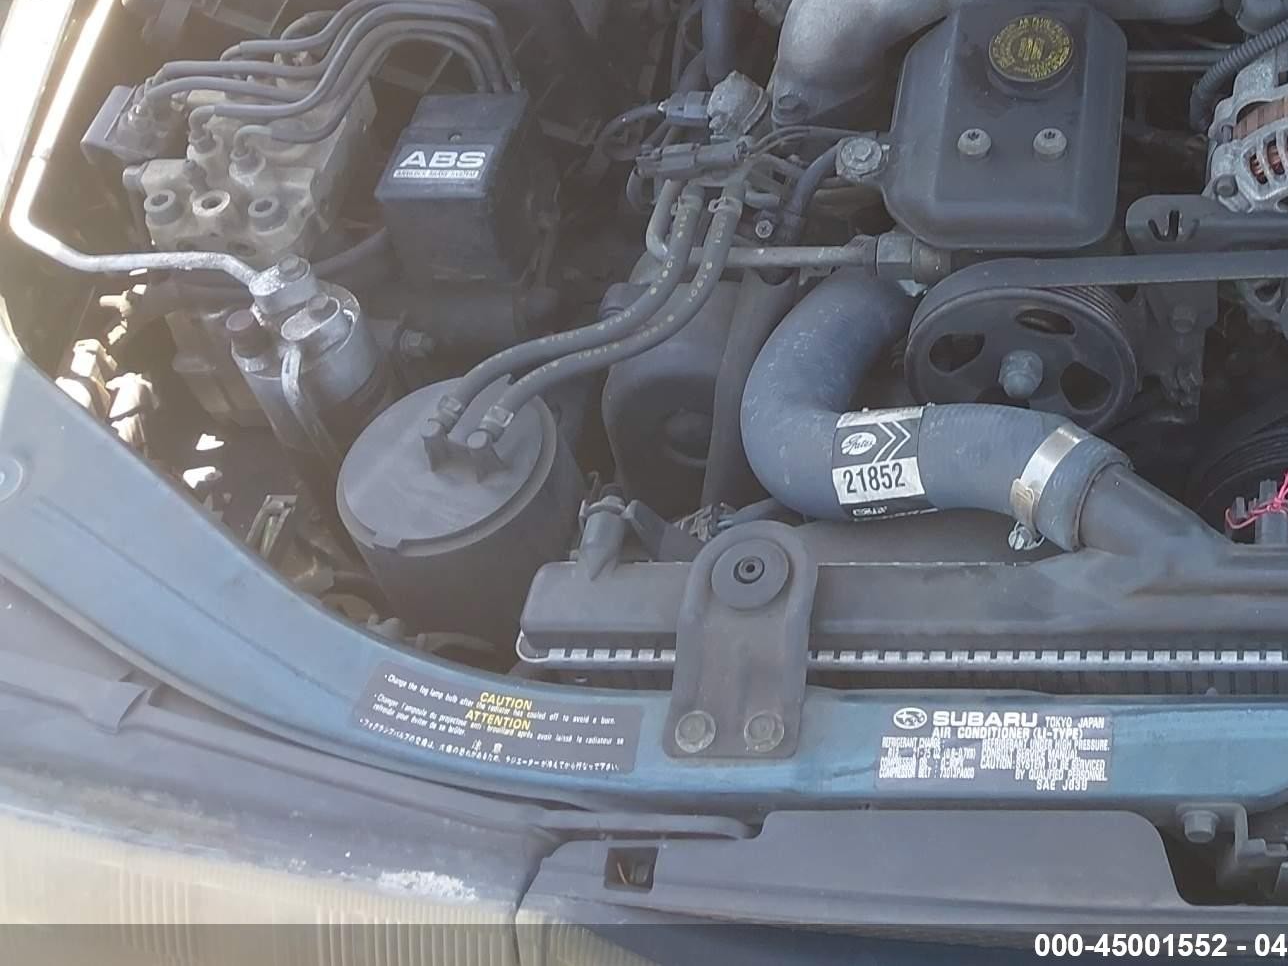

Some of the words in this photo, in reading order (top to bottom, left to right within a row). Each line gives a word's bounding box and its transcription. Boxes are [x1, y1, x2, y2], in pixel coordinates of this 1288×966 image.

[400, 151, 486, 168] ABS
[842, 462, 906, 494] 21852
[480, 692, 533, 711] CAUTION
[460, 698, 474, 707] after
[549, 712, 559, 722] off
[562, 715, 570, 723] to
[573, 715, 590, 724] avoid
[932, 710, 1038, 727] SUBARU
[1045, 716, 1073, 727] TOKYO
[1077, 716, 1105, 728] JAPAN
[465, 709, 532, 731] ATTENTION
[932, 726, 951, 738] AIR
[957, 726, 1029, 739] CONDITIONER
[1030, 738, 1053, 750] UNDER
[1055, 739, 1072, 750] HIGH
[1048, 759, 1057, 770] TO
[1015, 769, 1025, 780] BY
[1028, 770, 1064, 781] QUALIFIED
[1036, 779, 1056, 791] SAE
